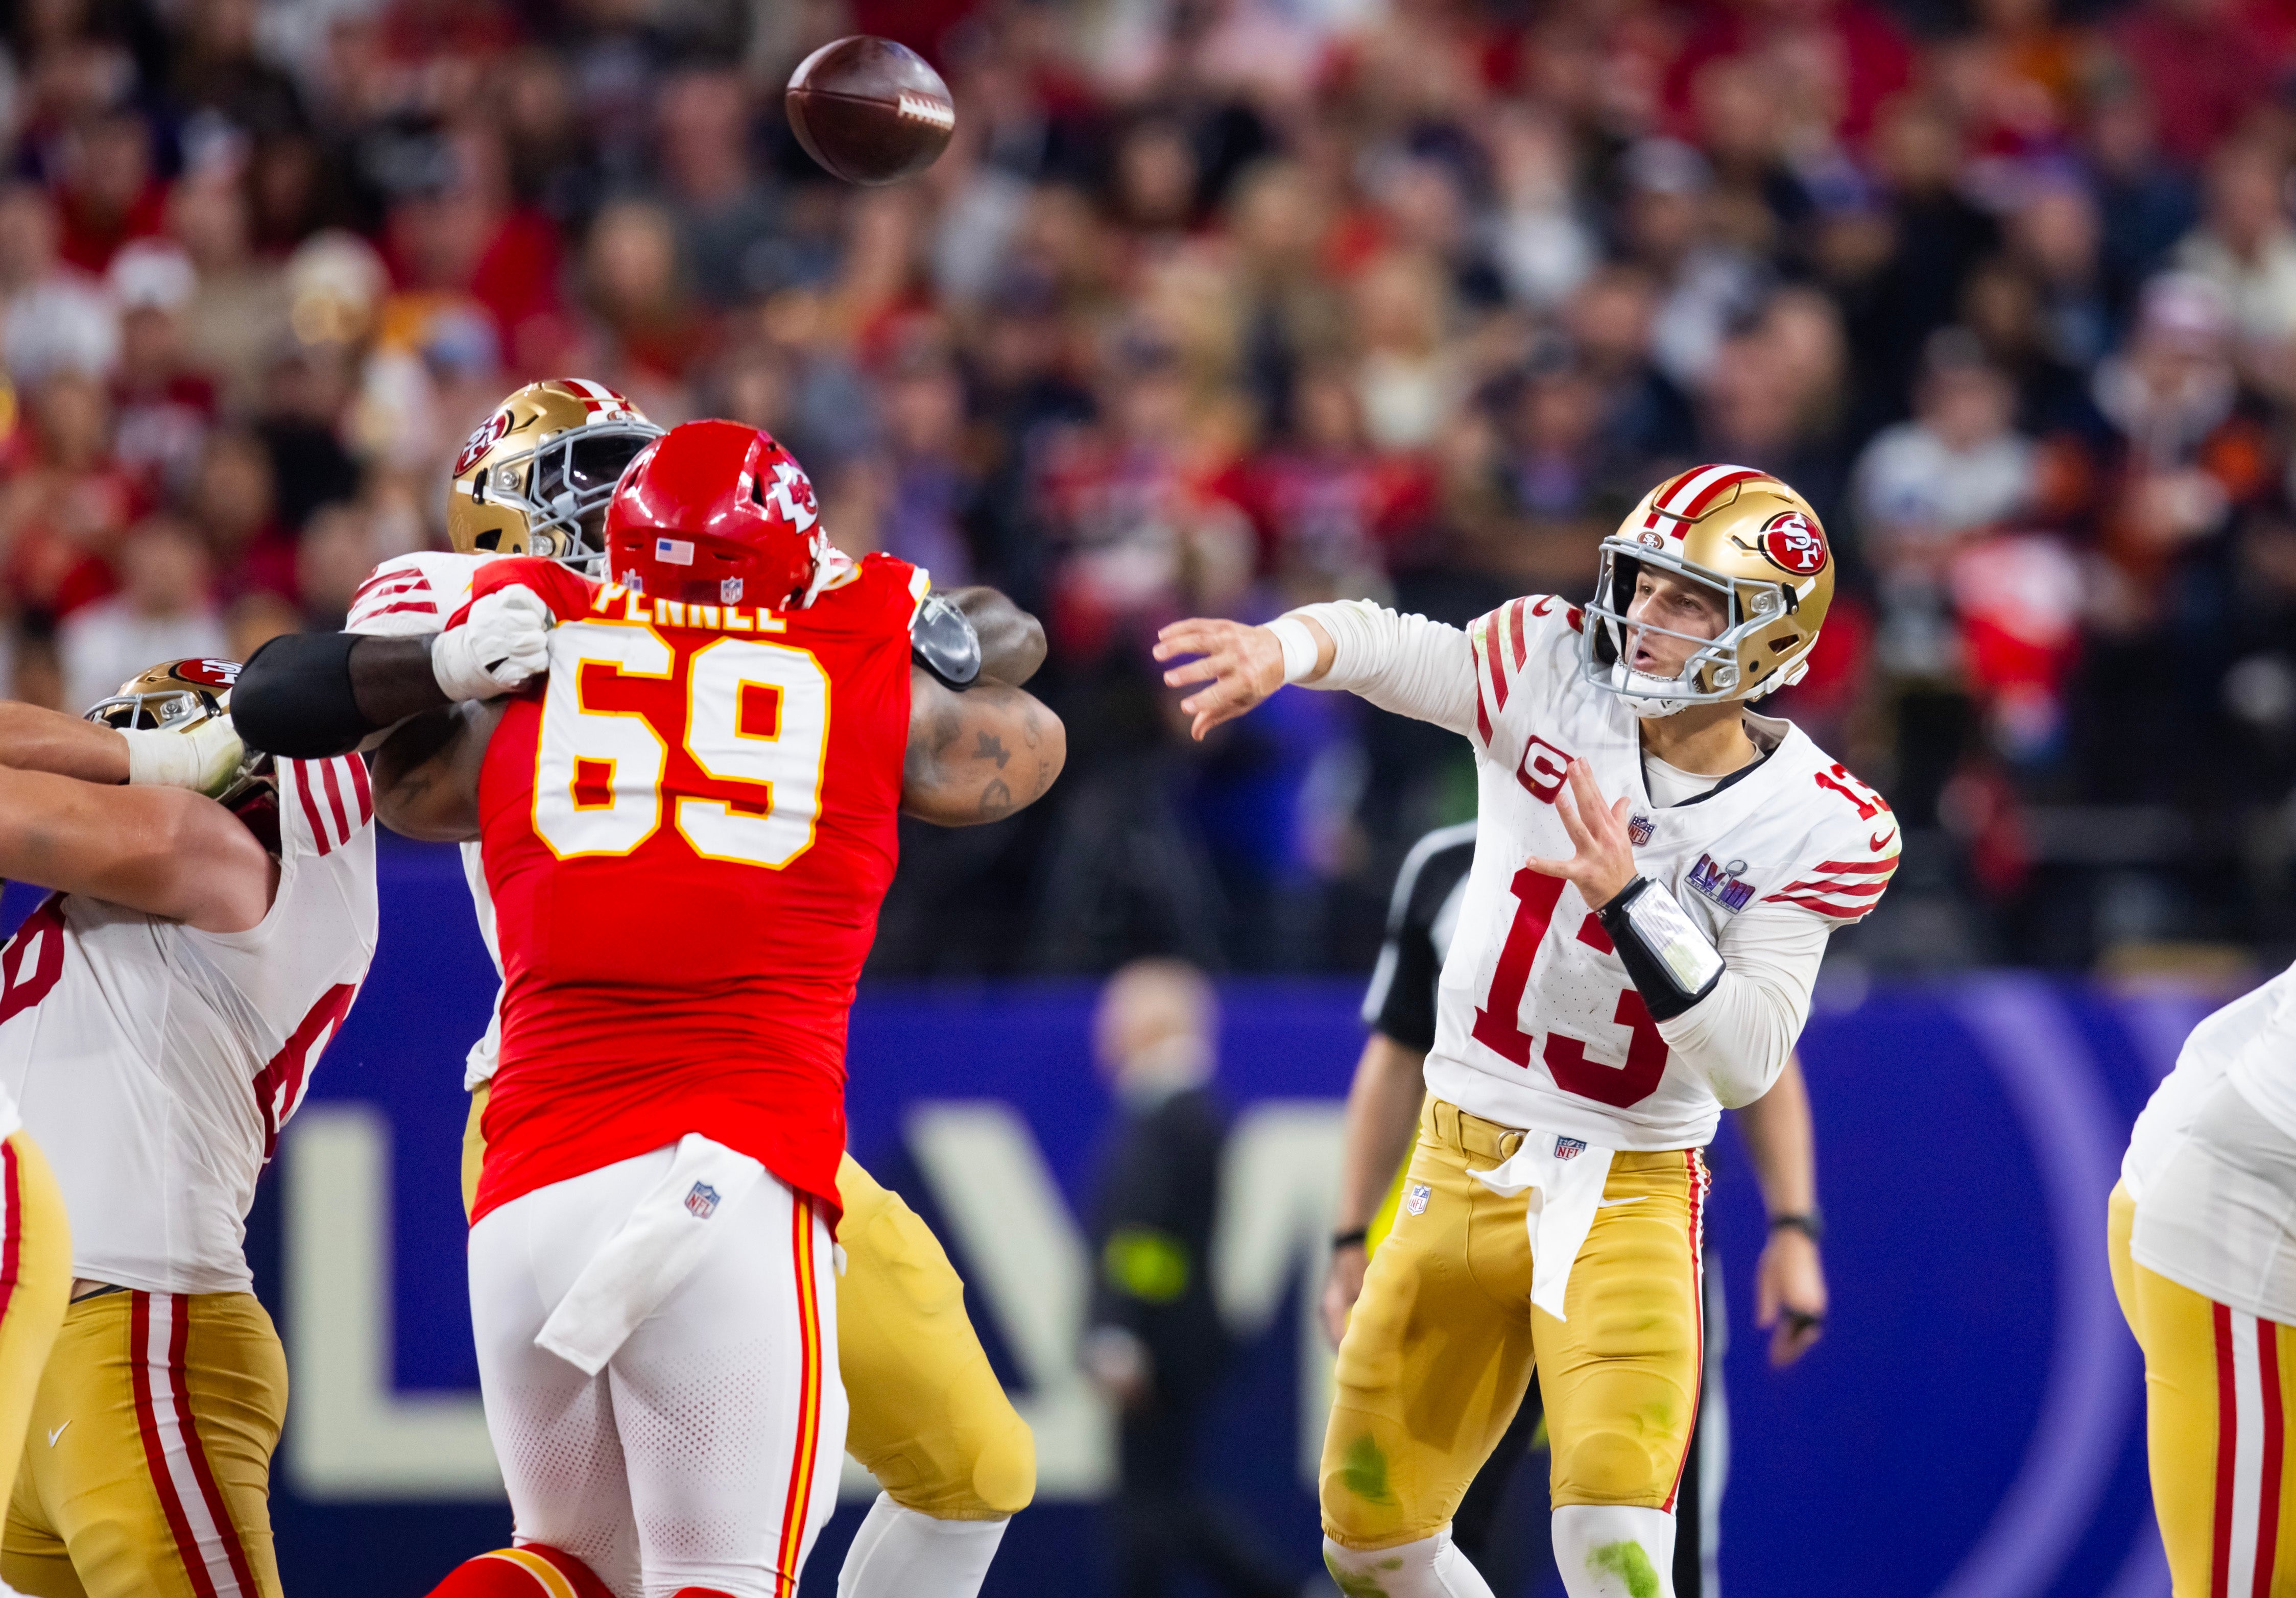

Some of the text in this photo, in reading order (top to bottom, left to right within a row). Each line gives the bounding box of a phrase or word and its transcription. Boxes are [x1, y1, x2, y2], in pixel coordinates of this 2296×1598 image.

[1781, 519, 1822, 568] SF
[531, 617, 831, 871] 69
[1524, 742, 1567, 789] C
[1629, 825, 1646, 843] NFL
[1690, 880, 1734, 912] SUPER BOWL
[1472, 865, 1669, 1109] 13
[687, 1194, 710, 1217] NFL
[1410, 1198, 1424, 1210] NFL
